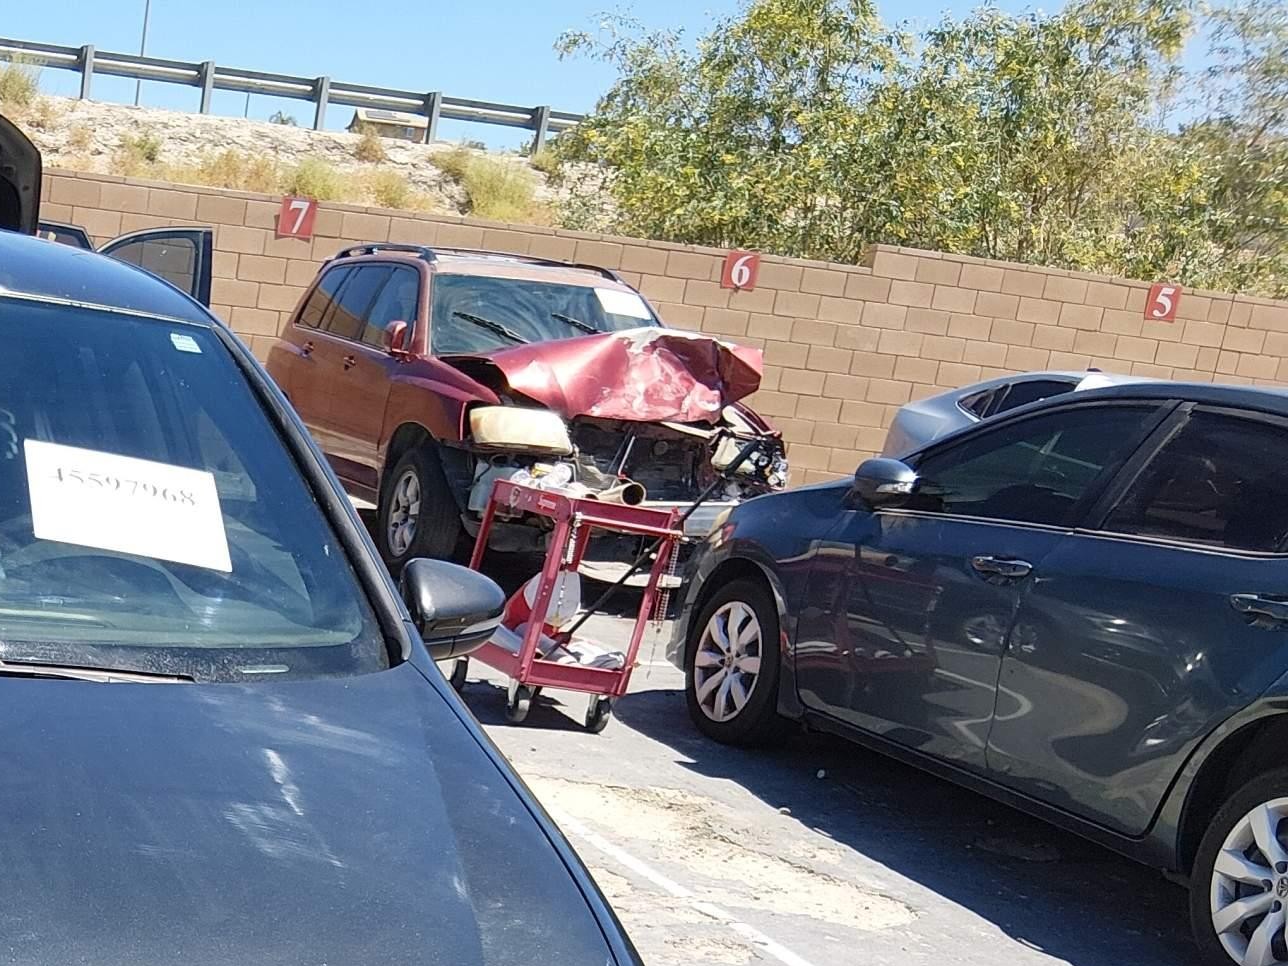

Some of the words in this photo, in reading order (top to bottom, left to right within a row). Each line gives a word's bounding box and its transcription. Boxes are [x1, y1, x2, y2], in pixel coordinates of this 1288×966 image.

[289, 200, 310, 234] 7
[731, 255, 754, 286] 6
[1152, 287, 1176, 317] 5
